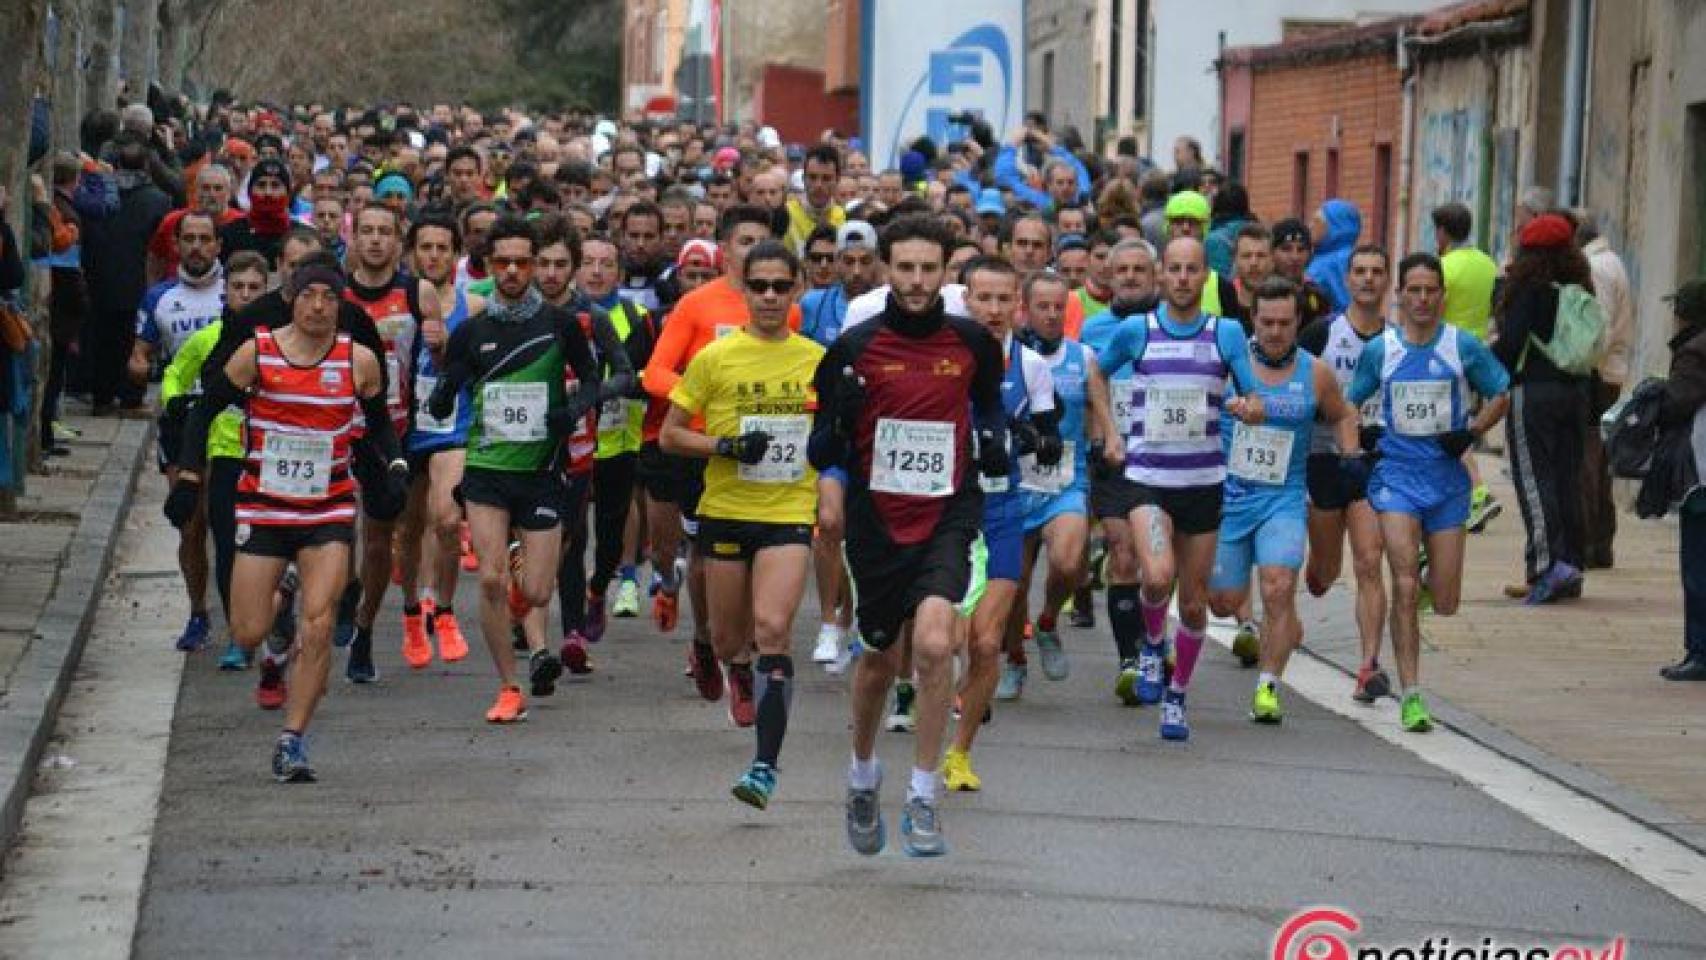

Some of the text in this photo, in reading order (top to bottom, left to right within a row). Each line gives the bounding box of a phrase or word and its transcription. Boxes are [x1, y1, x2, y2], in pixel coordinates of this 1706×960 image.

[504, 405, 528, 425] 96
[1162, 407, 1188, 424] 38
[1406, 401, 1438, 420] 591
[887, 449, 945, 473] 1258
[1245, 446, 1277, 466] 133
[276, 458, 315, 480] 873
